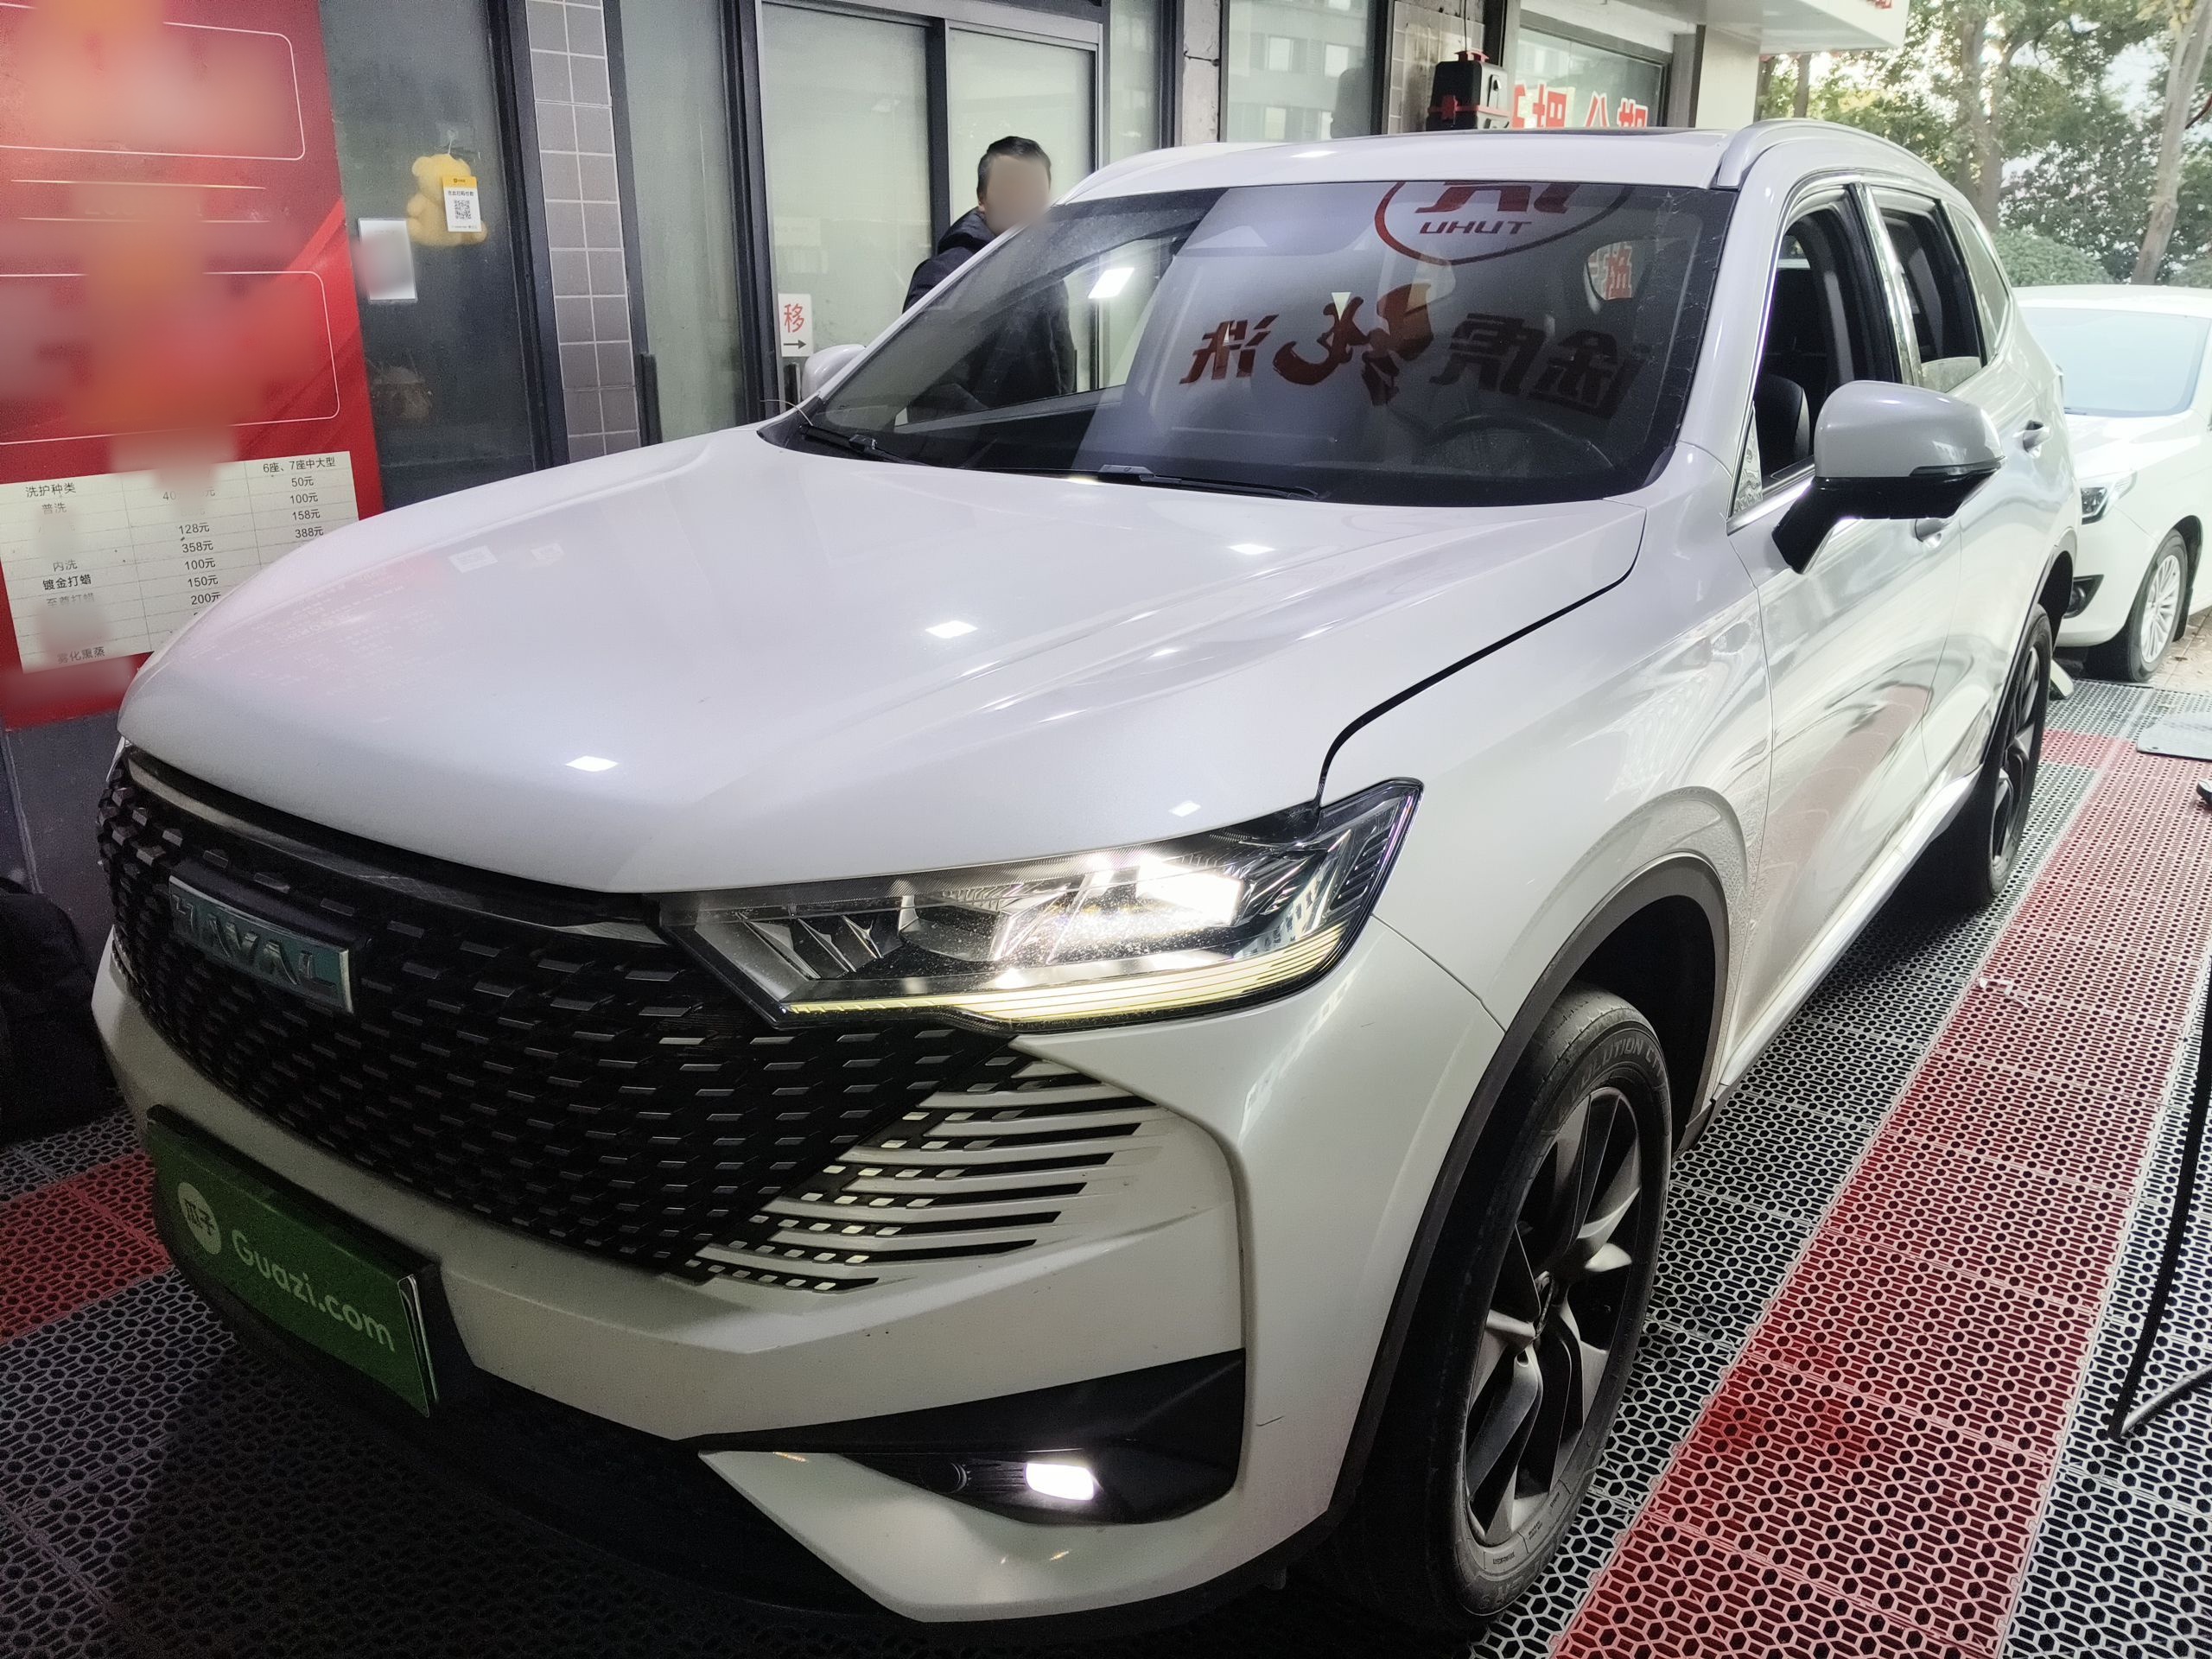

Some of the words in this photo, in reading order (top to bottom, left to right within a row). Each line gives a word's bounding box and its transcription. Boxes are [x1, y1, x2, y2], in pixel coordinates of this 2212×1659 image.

[784, 302, 804, 334] 移
[263, 456, 336, 474] 6座、7座中大型
[291, 475, 315, 487] 50元
[25, 481, 76, 498] 洗护种类
[290, 492, 319, 505] 100元
[292, 508, 321, 521] 158元
[178, 522, 210, 535] 128元
[295, 525, 324, 538] 388元
[181, 540, 213, 553] 358元
[53, 558, 79, 572] 内洗
[184, 557, 216, 570] 100元
[42, 574, 92, 591] 镀金打蜡
[188, 575, 219, 588] 150元
[190, 591, 221, 605] 200元
[169, 894, 337, 994] HAVAL
[231, 1228, 396, 1353] Guazi.com
